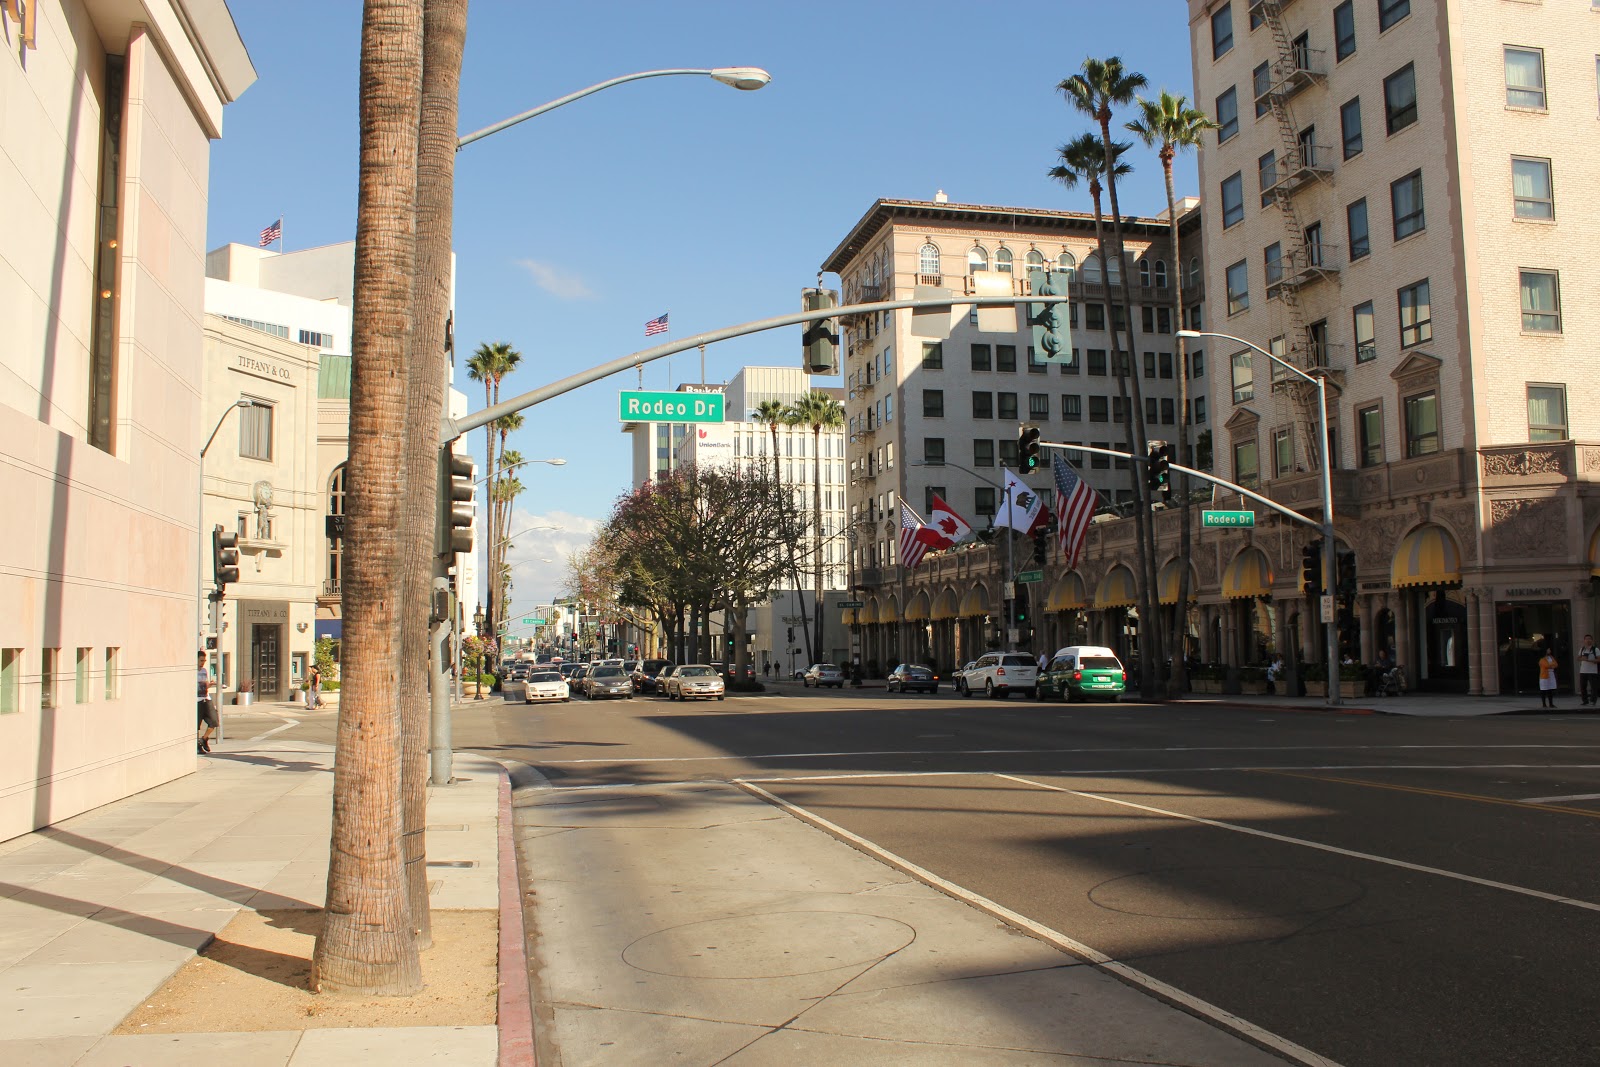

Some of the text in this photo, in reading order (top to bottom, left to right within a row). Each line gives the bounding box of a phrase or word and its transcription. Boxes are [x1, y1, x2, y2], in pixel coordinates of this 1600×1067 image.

[238, 355, 290, 379] TIFFANY & CO.
[628, 398, 716, 416] Rodeo Dr
[1207, 514, 1250, 524] Rodeo Dr
[1505, 587, 1562, 596] MIKIMOTO
[247, 609, 270, 618] TIFFANY
